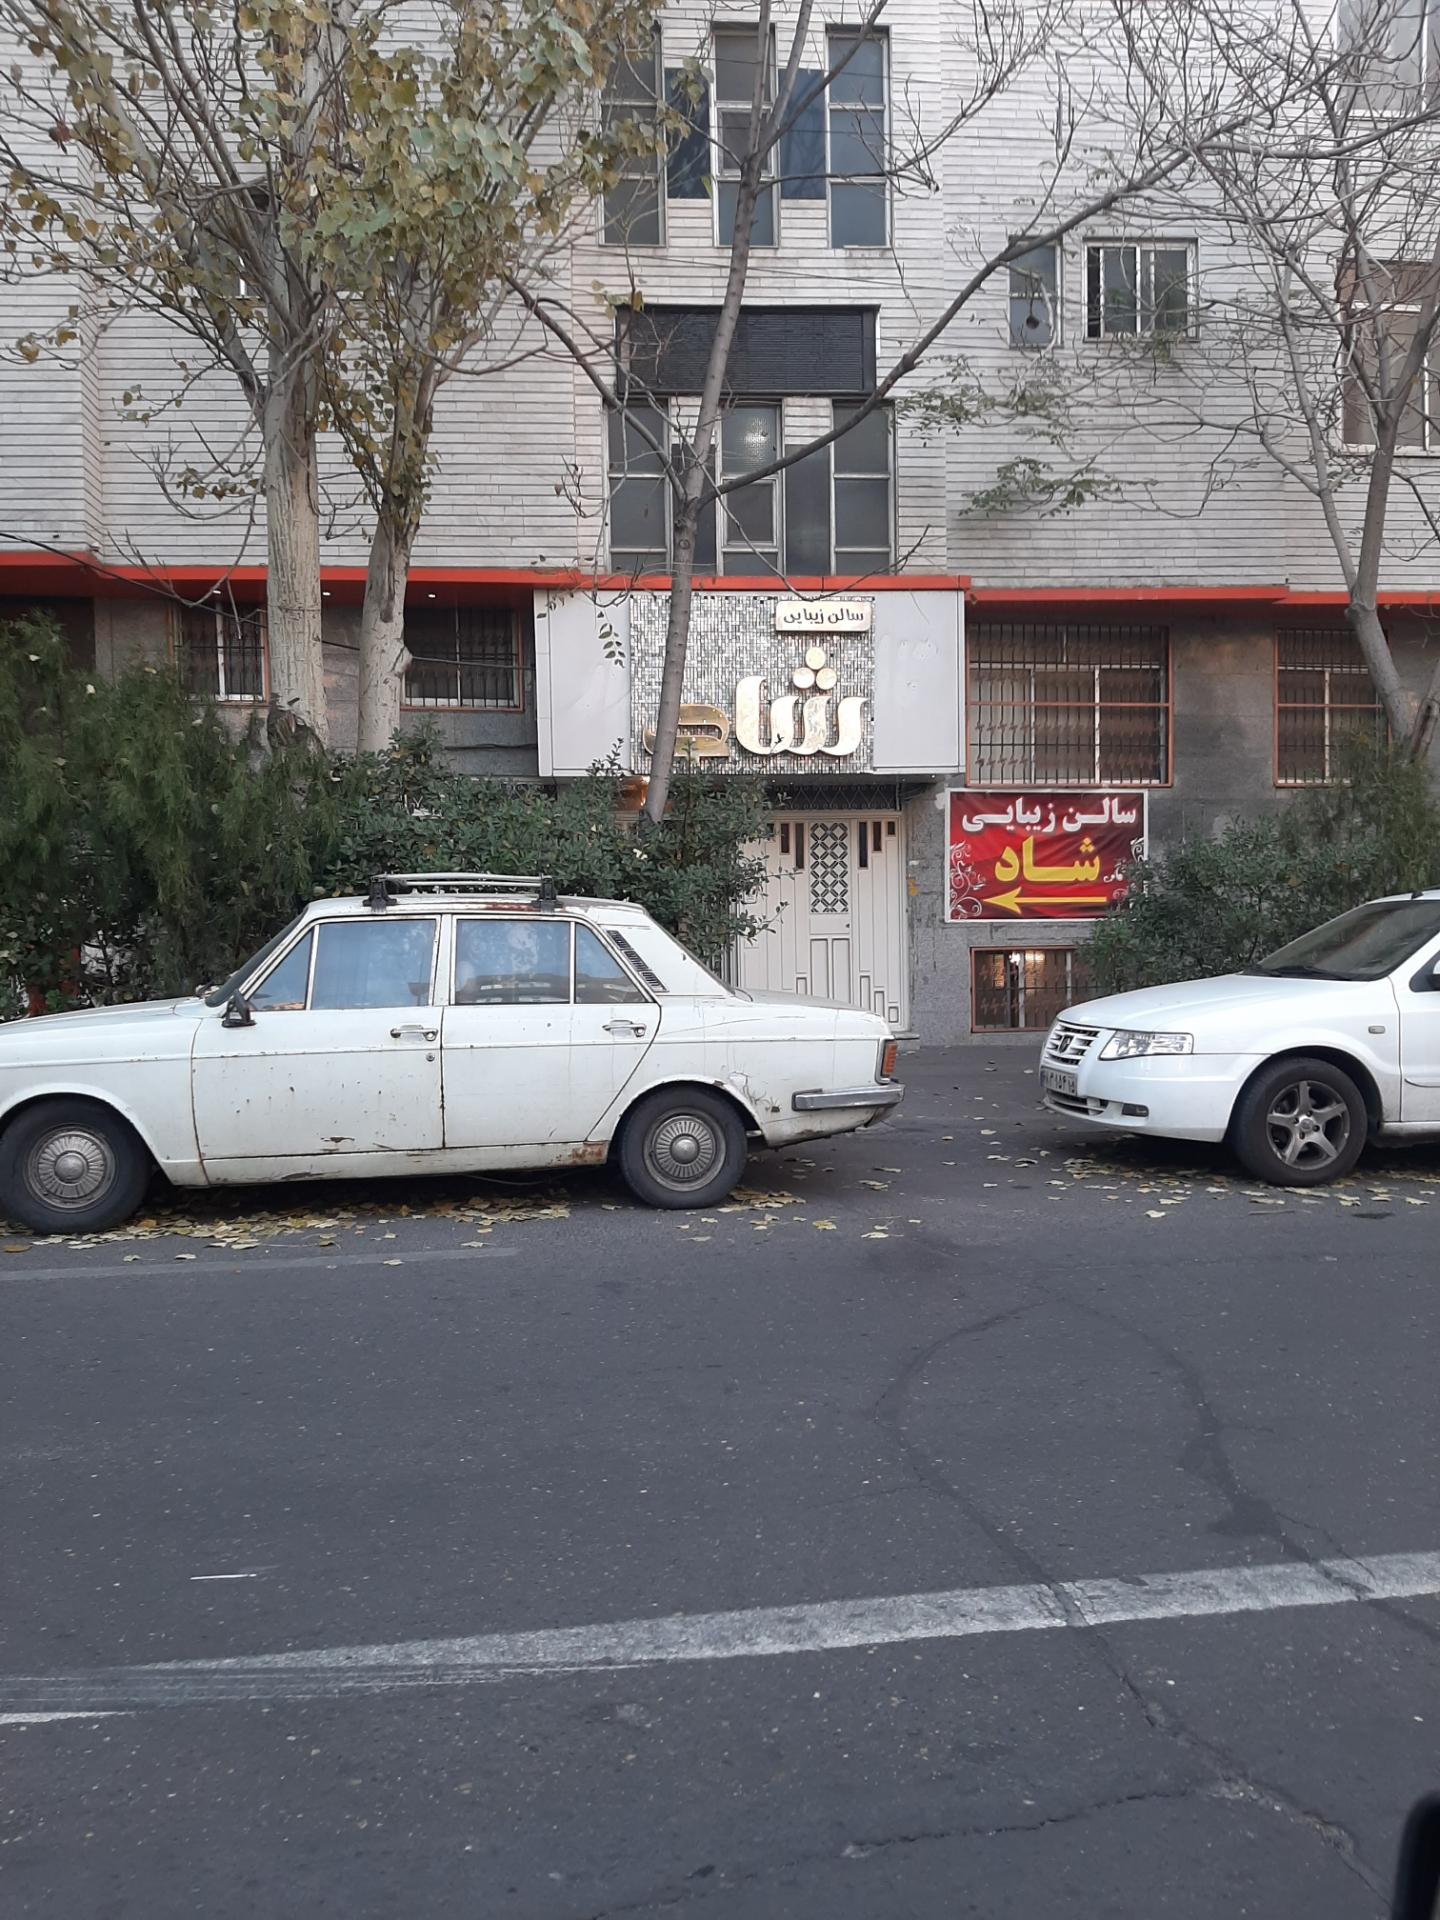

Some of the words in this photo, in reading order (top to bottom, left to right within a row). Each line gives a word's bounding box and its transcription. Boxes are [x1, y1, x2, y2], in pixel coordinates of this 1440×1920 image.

[783, 608, 824, 624] زیبایی
[827, 608, 864, 624] سالن
[961, 797, 1056, 833] زیبایی
[1062, 797, 1137, 832] سالن
[994, 835, 1101, 882] شاد
